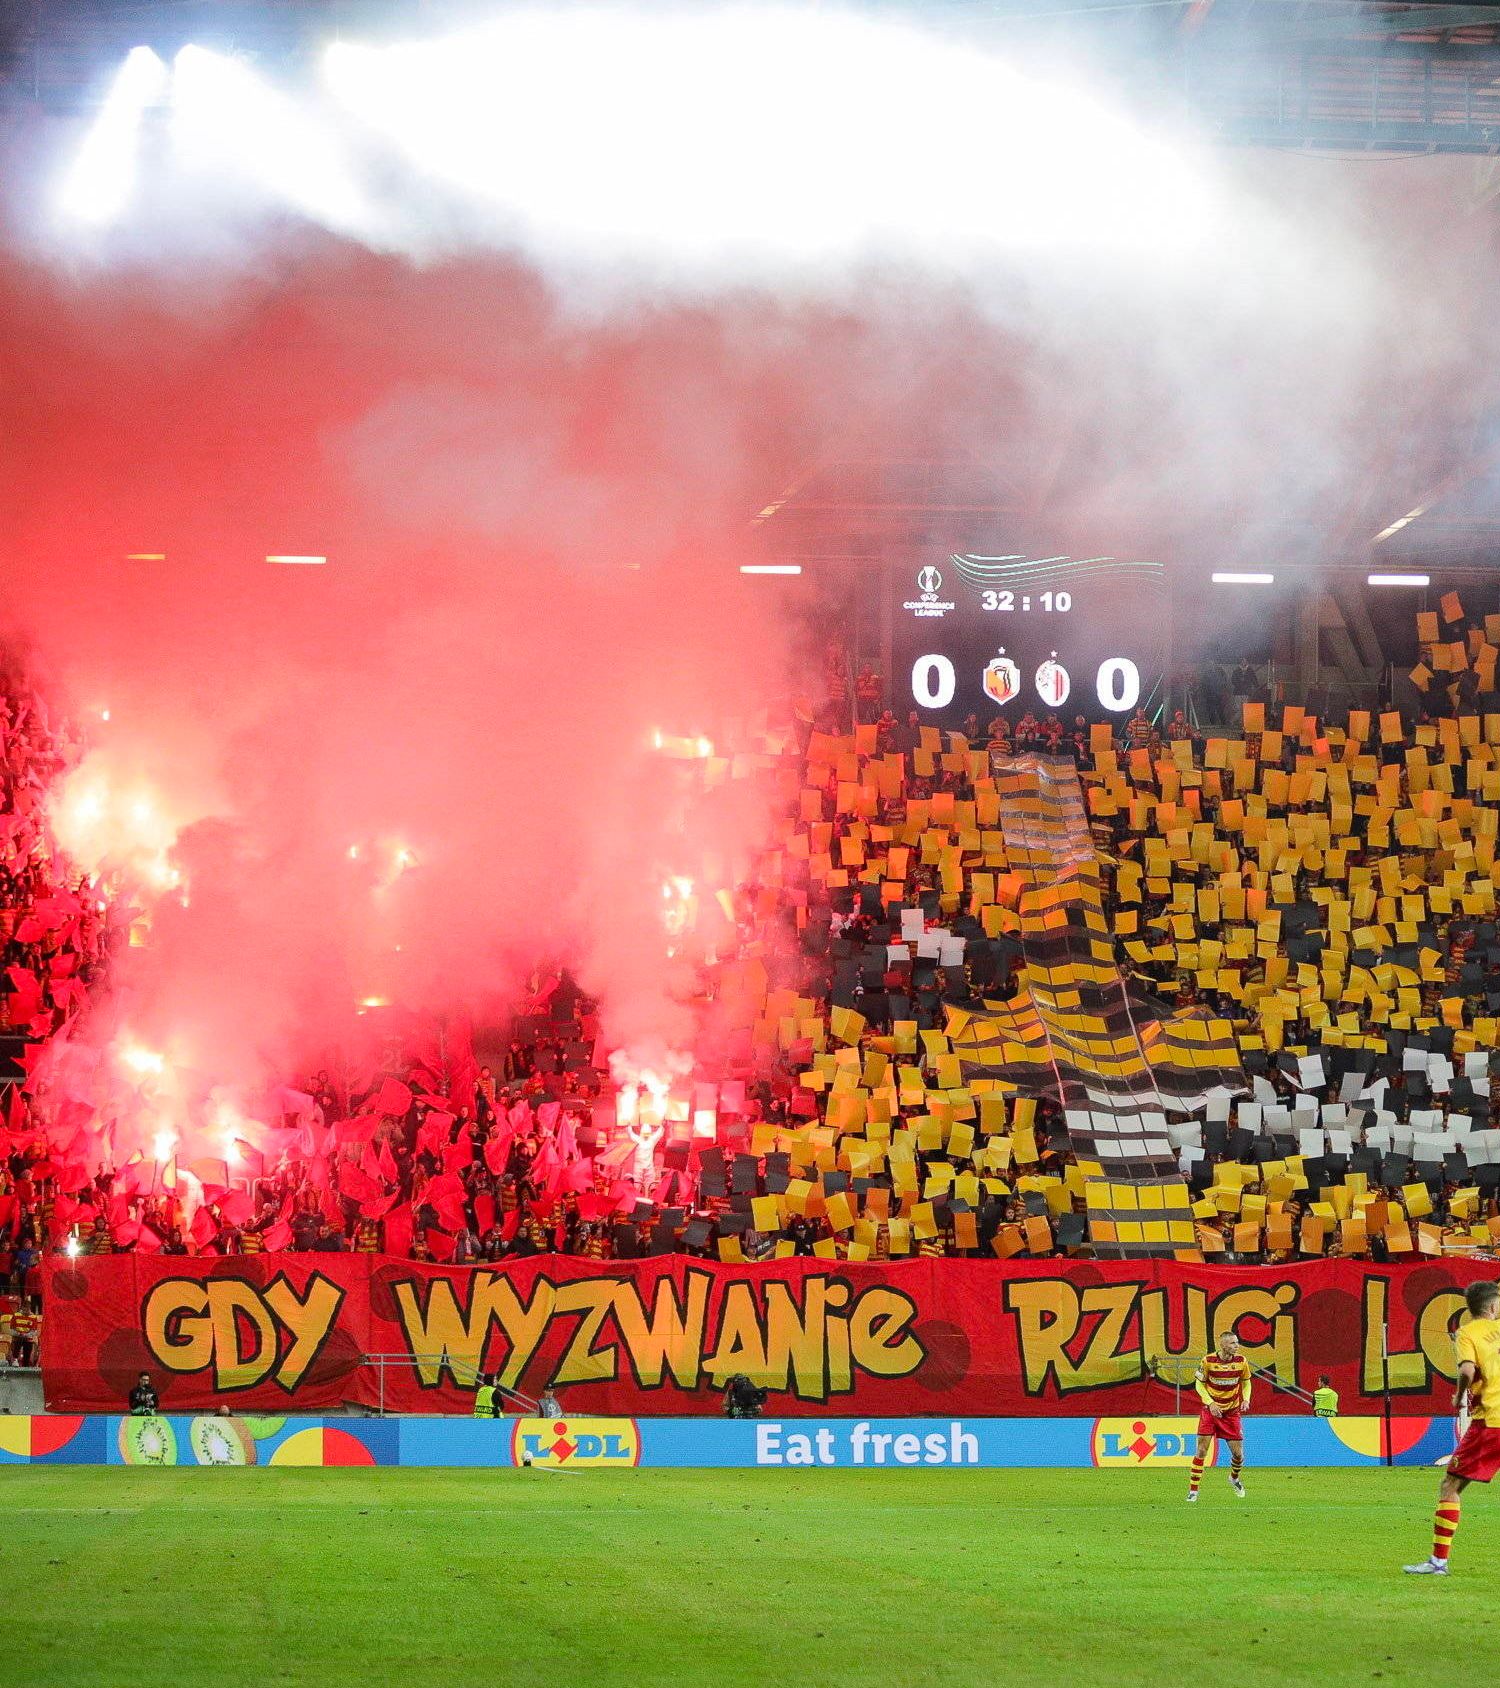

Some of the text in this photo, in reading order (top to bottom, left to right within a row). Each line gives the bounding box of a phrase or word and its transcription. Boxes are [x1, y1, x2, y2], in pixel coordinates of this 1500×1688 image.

[912, 654, 956, 709] 0
[1096, 657, 1140, 712] 0
[140, 1269, 347, 1396] GDY
[756, 1421, 979, 1464] Eat fresh
